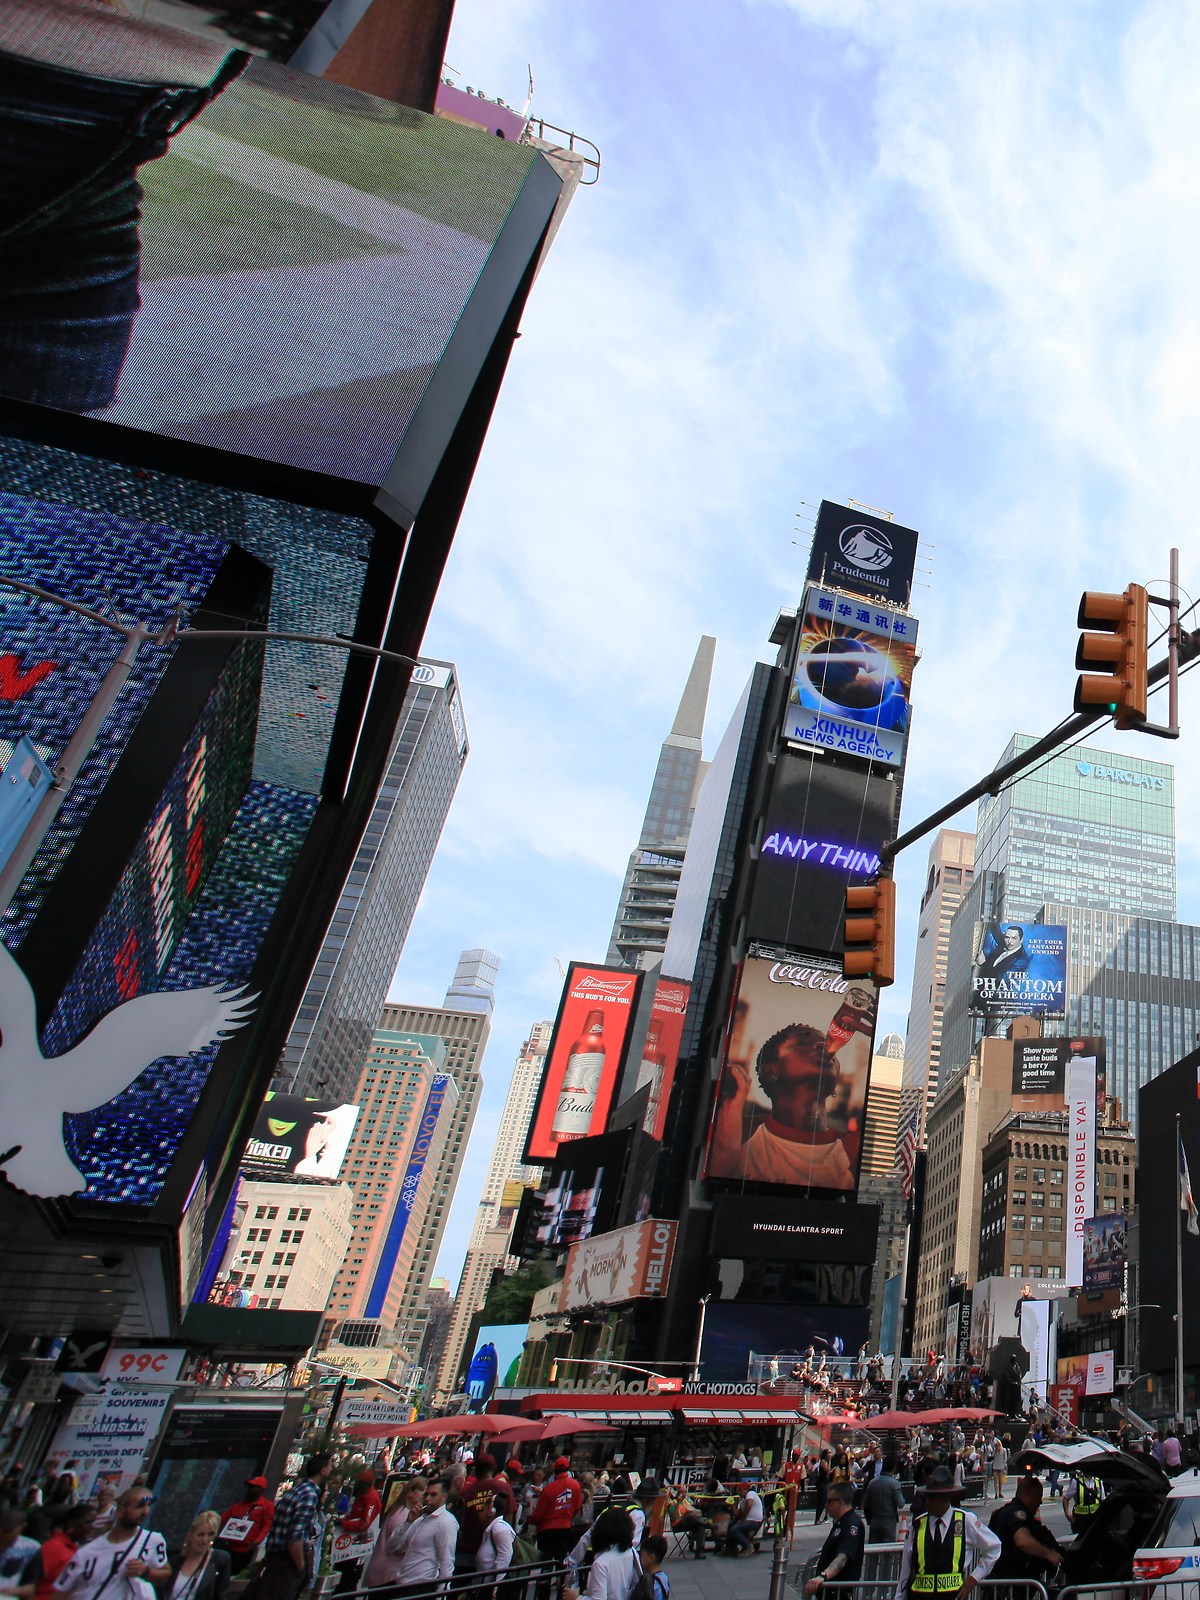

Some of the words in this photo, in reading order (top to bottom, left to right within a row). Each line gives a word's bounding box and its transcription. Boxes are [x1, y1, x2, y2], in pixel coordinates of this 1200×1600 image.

[833, 561, 890, 587] Prudential
[818, 597, 907, 635] 新华通讯社
[812, 717, 880, 747] XINHUA
[794, 726, 834, 745] NEWS
[837, 737, 894, 761] AGENCY
[1095, 765, 1166, 790] BARCLAYS
[582, 979, 624, 991] Budweiser
[768, 962, 850, 994] Coca-Cola
[973, 977, 1063, 993] PHANTOM
[1007, 971, 1029, 979] THE
[585, 993, 603, 1001] BUD'S
[604, 995, 616, 1003] FOR
[617, 997, 630, 1005] YOU.
[980, 991, 995, 999] OF
[996, 991, 1018, 999] THE
[1020, 992, 1054, 1001] OPERA
[1042, 1047, 1058, 1055] your
[1076, 1101, 1086, 1126] YA!
[410, 1083, 447, 1165] NOVOTEL
[1074, 1131, 1086, 1238] ¡DISPONIBLE
[753, 1223, 785, 1231] HYUNDAI
[787, 1225, 820, 1234] ELANTRA
[821, 1227, 844, 1235] SPORT
[645, 1223, 671, 1292] HELLO!
[119, 1353, 168, 1373] 99¢
[558, 1373, 662, 1396] nuchas
[685, 1382, 705, 1395] NYC
[706, 1382, 757, 1396] HOTDOGS
[107, 1399, 166, 1408] SOUVENIRS
[348, 1403, 380, 1411] PEDESTRIAN
[381, 1403, 395, 1412] FLOW
[395, 1405, 410, 1413] ZONE
[1058, 1388, 1073, 1423] tkts
[372, 1412, 387, 1420] KEEP
[387, 1413, 408, 1422] MOVING
[72, 1449, 119, 1457] SOUVENIR
[937, 1574, 961, 1589] SQUARE
